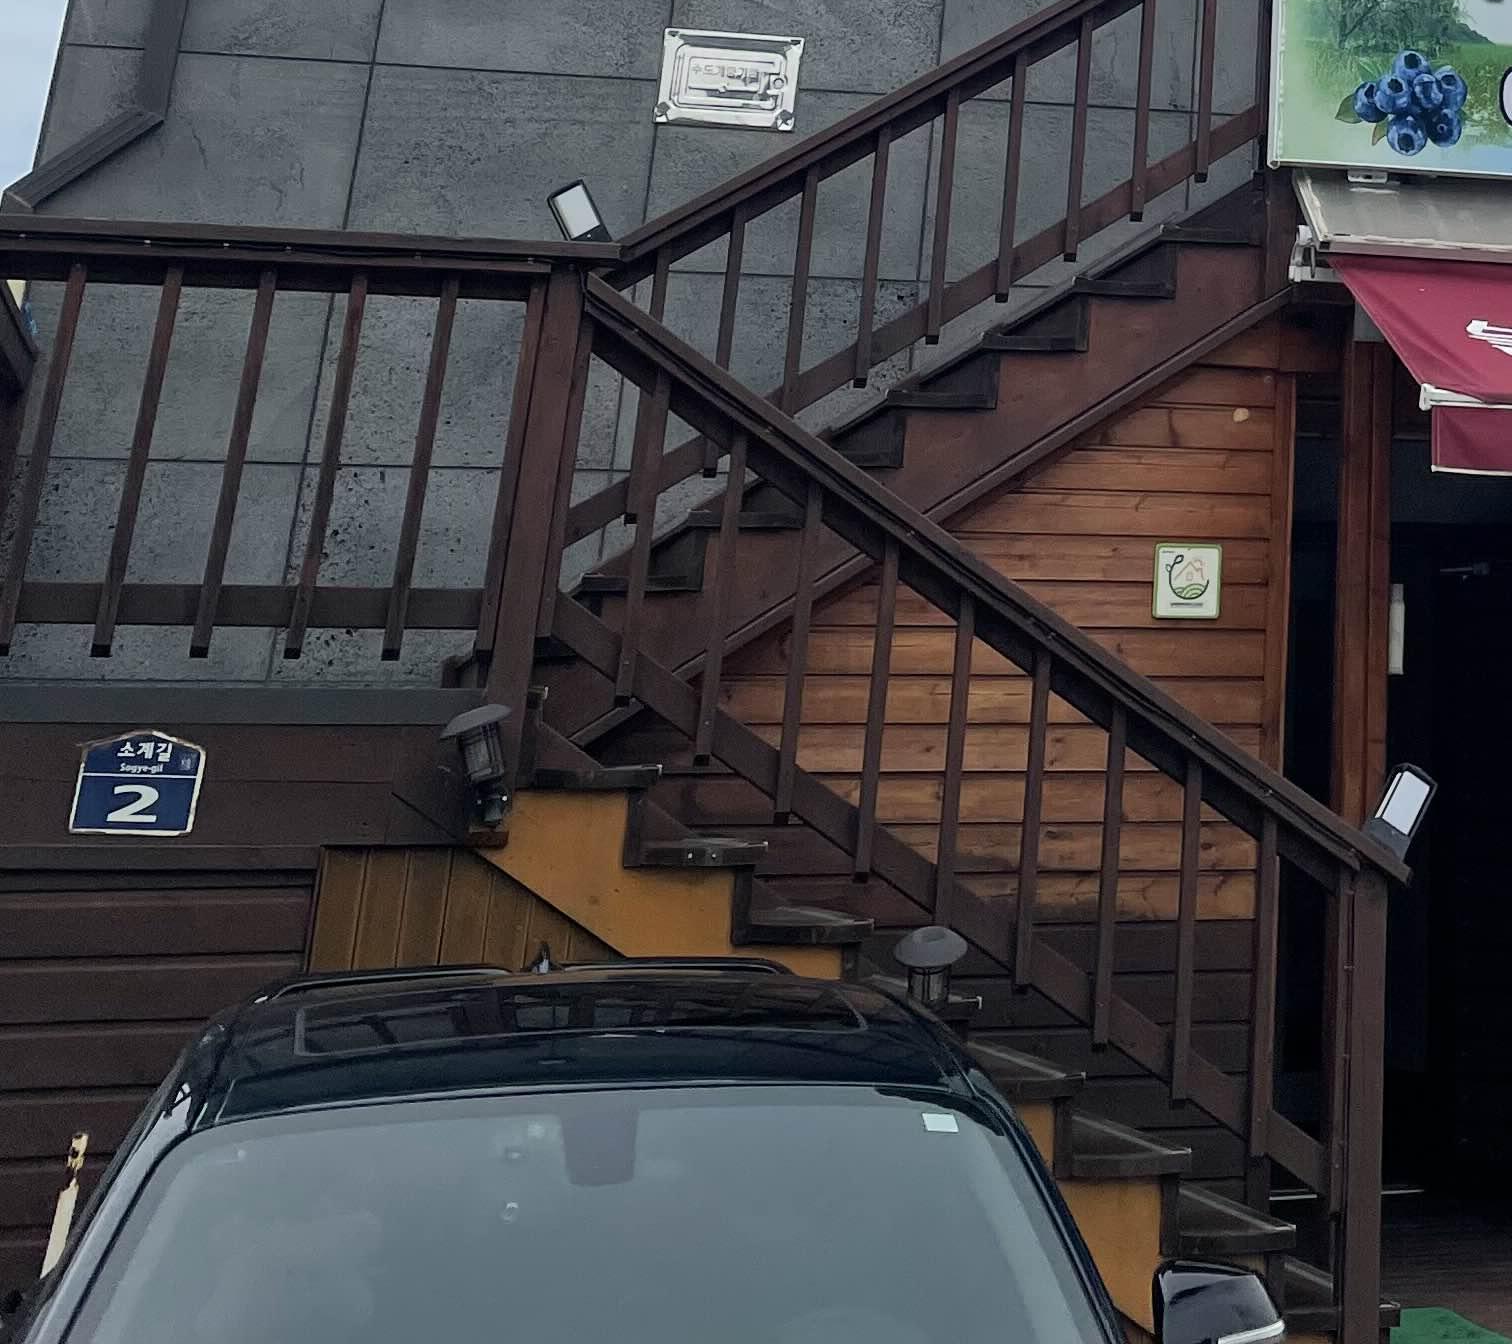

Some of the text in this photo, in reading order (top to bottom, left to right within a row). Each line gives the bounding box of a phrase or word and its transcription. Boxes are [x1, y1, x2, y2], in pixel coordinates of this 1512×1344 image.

[117, 741, 173, 763] 소계길
[120, 762, 164, 774] Sogye-gil
[106, 784, 160, 823] 2
